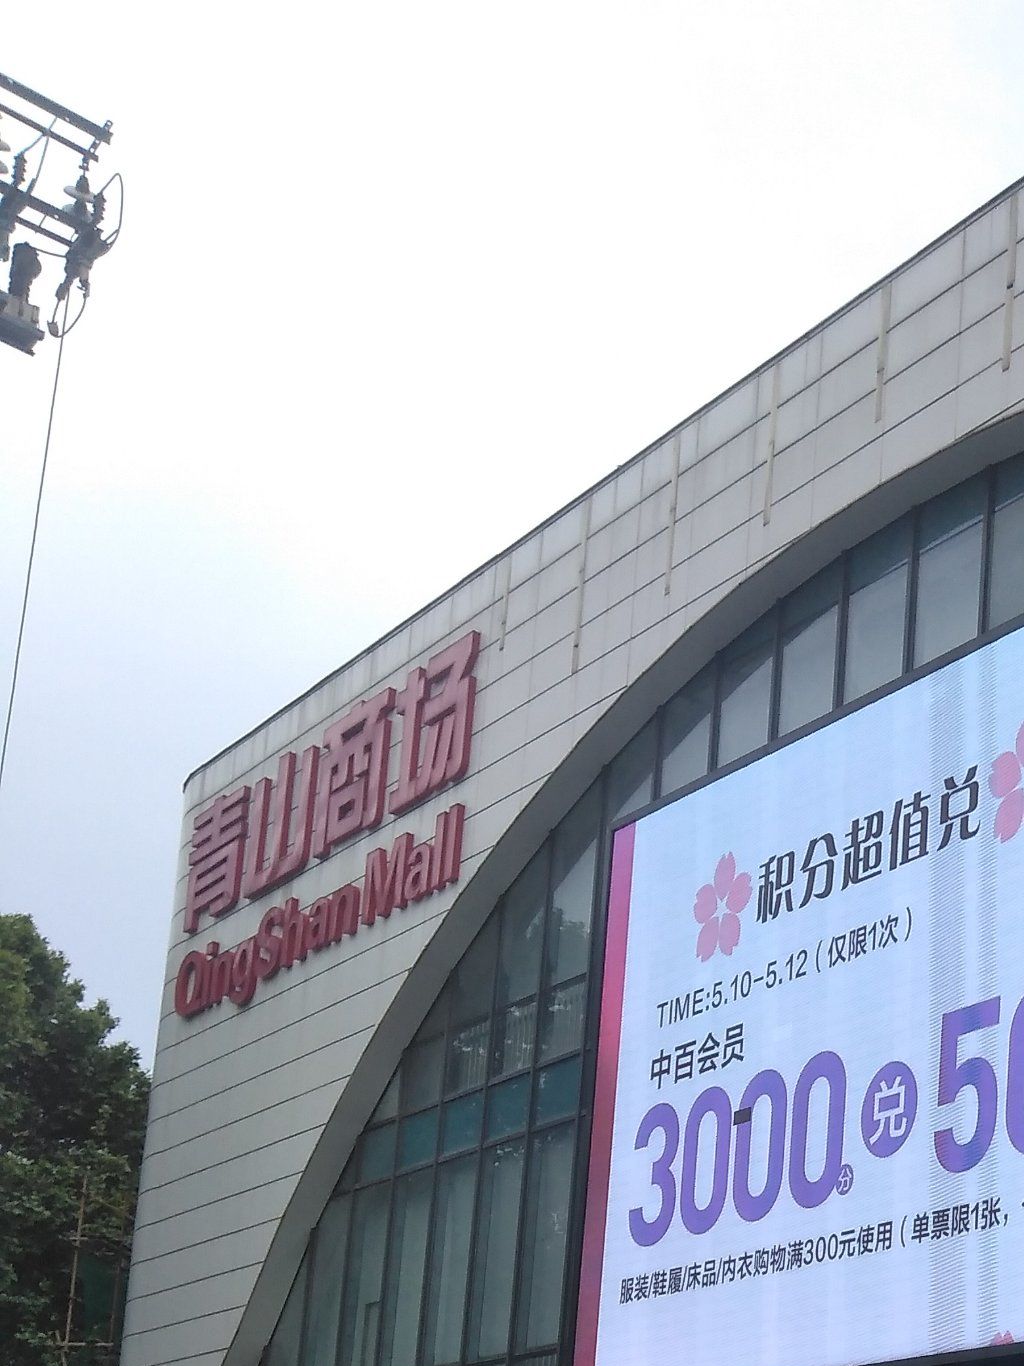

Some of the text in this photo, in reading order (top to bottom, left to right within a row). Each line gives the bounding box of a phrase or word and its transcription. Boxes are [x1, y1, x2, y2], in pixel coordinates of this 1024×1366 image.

[183, 630, 481, 934] 青山商场
[755, 765, 981, 924] 积分超值兑
[362, 803, 466, 927] Mall
[650, 1022, 745, 1090] 中百会员
